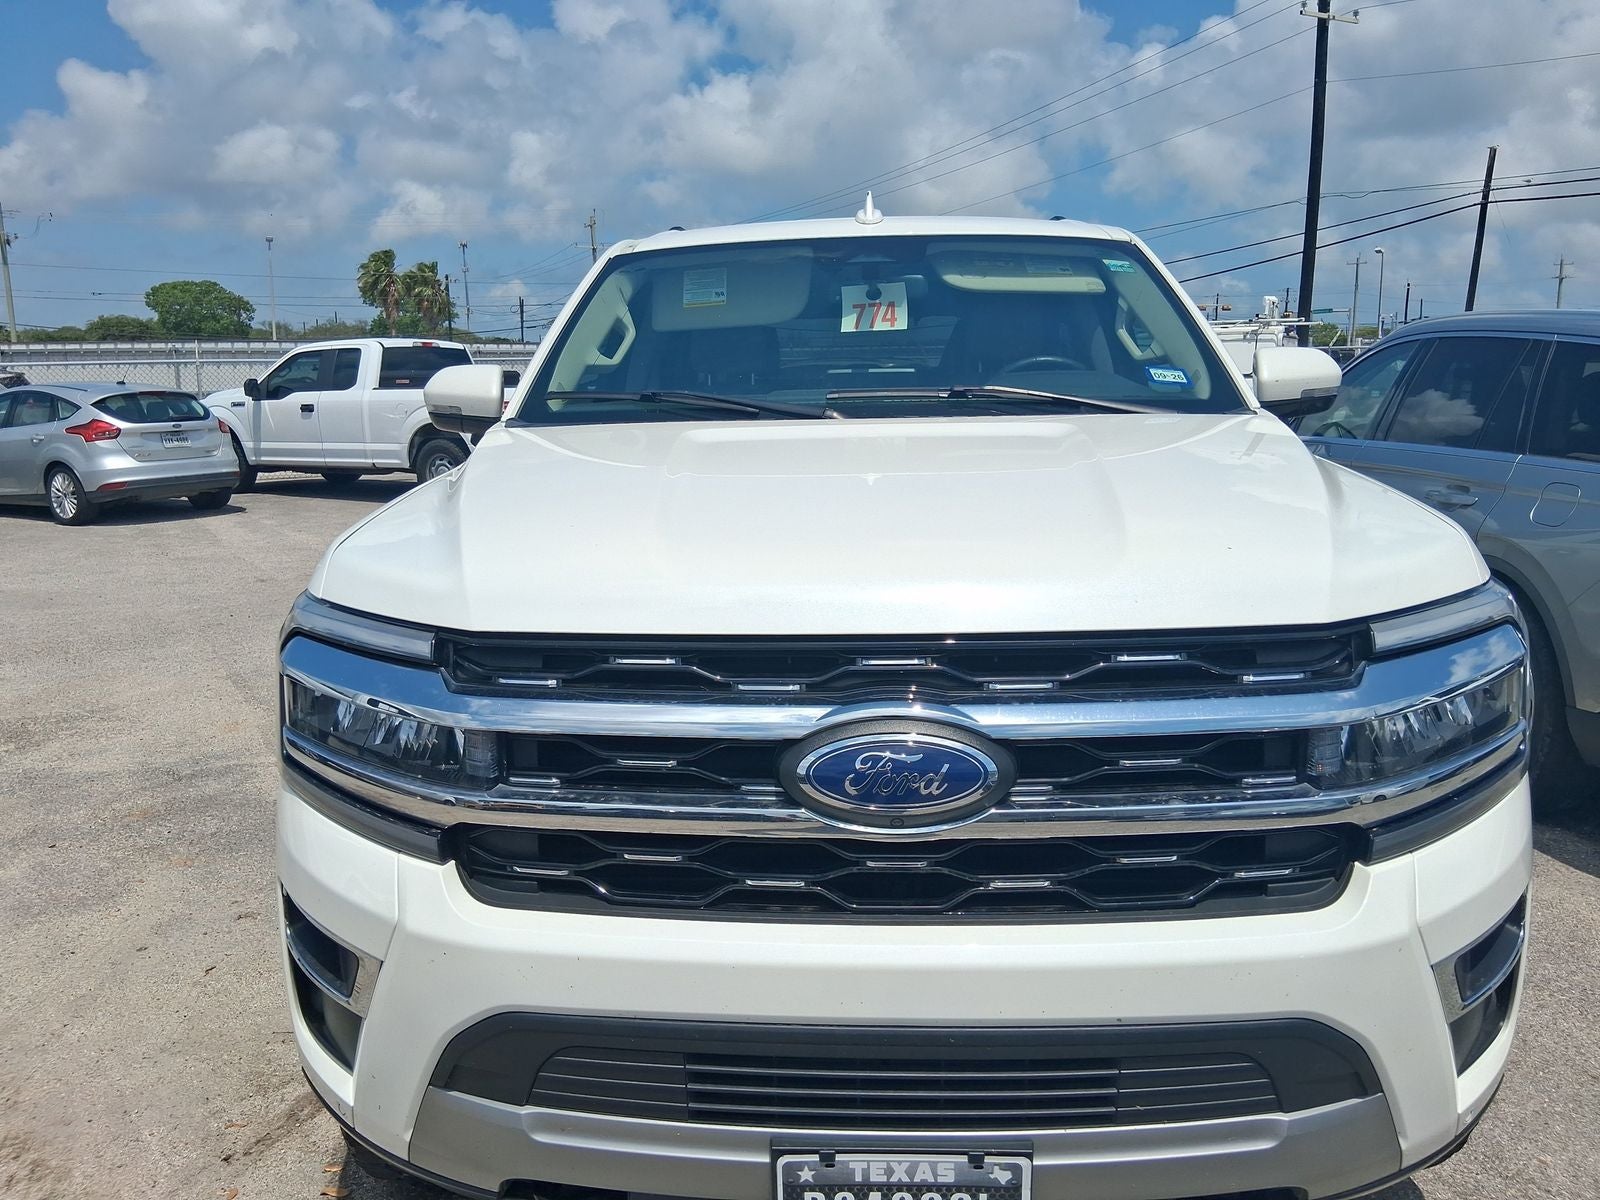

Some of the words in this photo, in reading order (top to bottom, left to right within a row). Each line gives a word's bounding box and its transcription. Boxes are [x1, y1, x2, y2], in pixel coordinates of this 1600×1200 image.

[852, 301, 898, 330] 774
[844, 752, 950, 796] Ford
[849, 1161, 955, 1184] TEXAS
